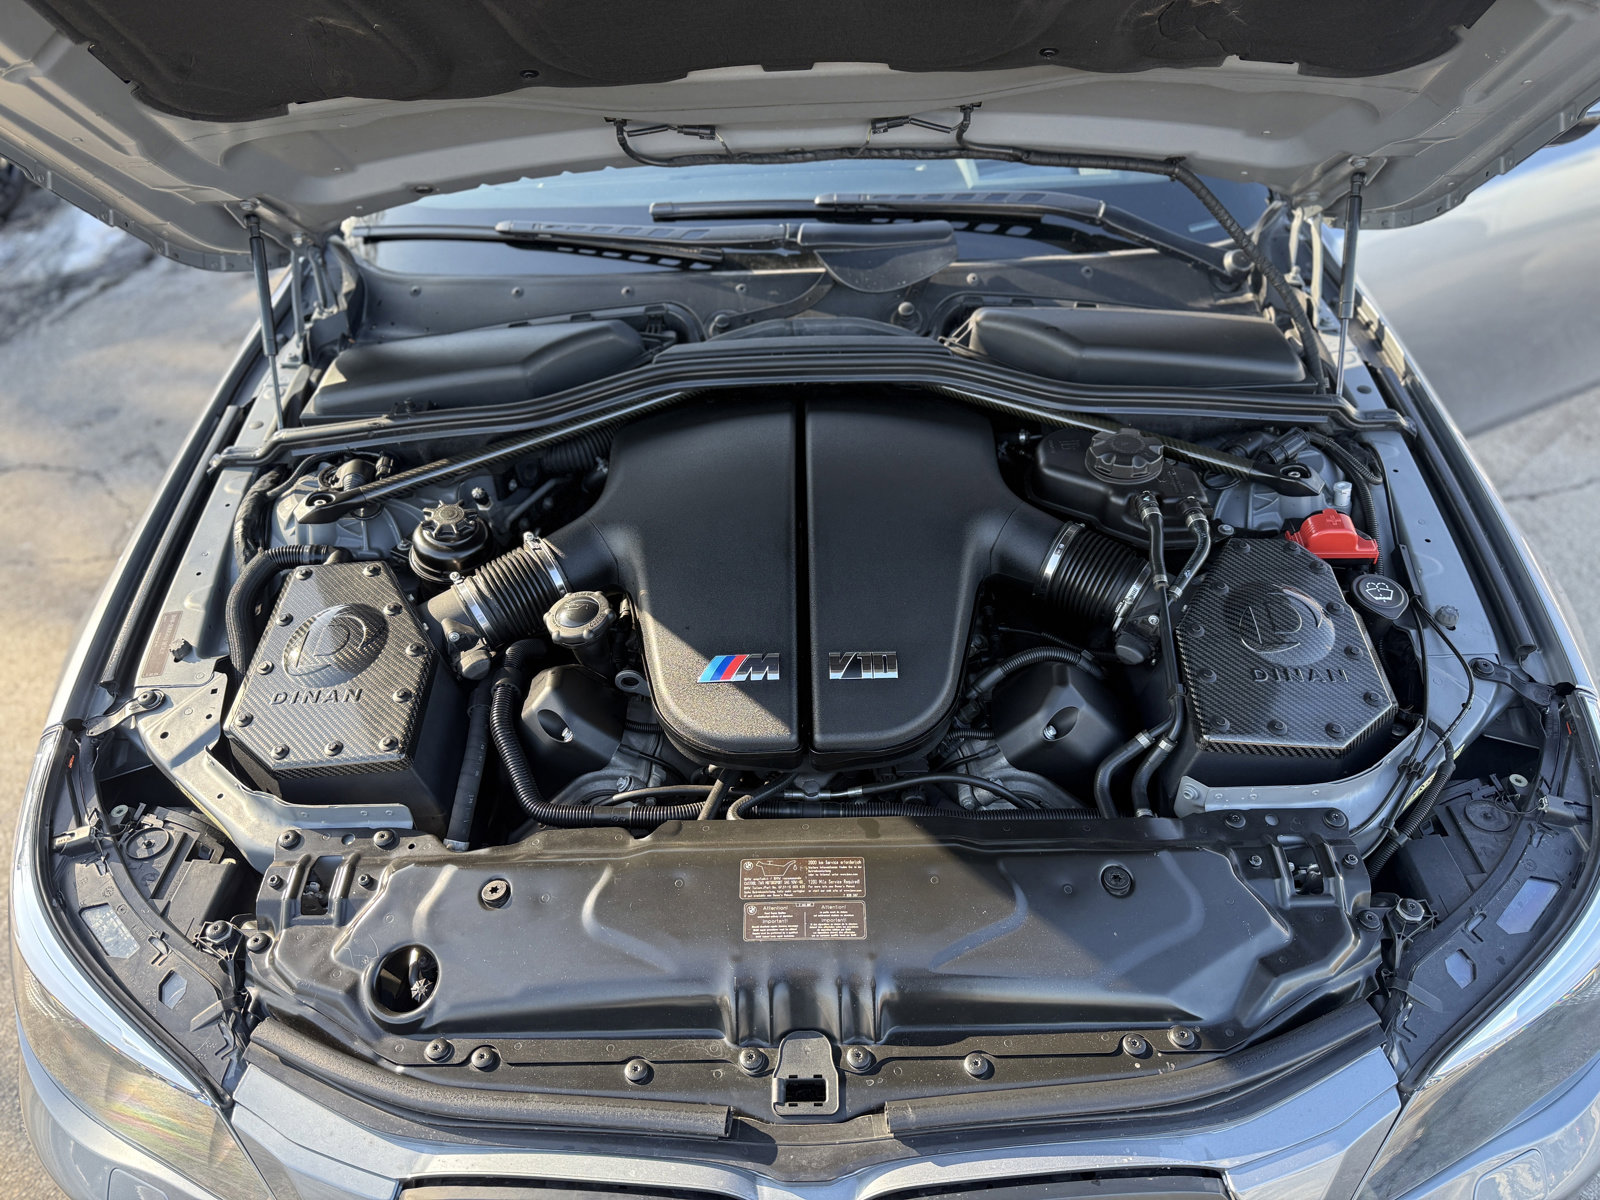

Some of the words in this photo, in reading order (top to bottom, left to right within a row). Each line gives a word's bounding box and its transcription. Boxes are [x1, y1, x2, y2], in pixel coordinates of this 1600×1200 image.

[731, 652, 779, 682] M
[829, 652, 898, 680] V10
[1253, 669, 1348, 682] DINAN
[270, 688, 364, 706] DINAN
